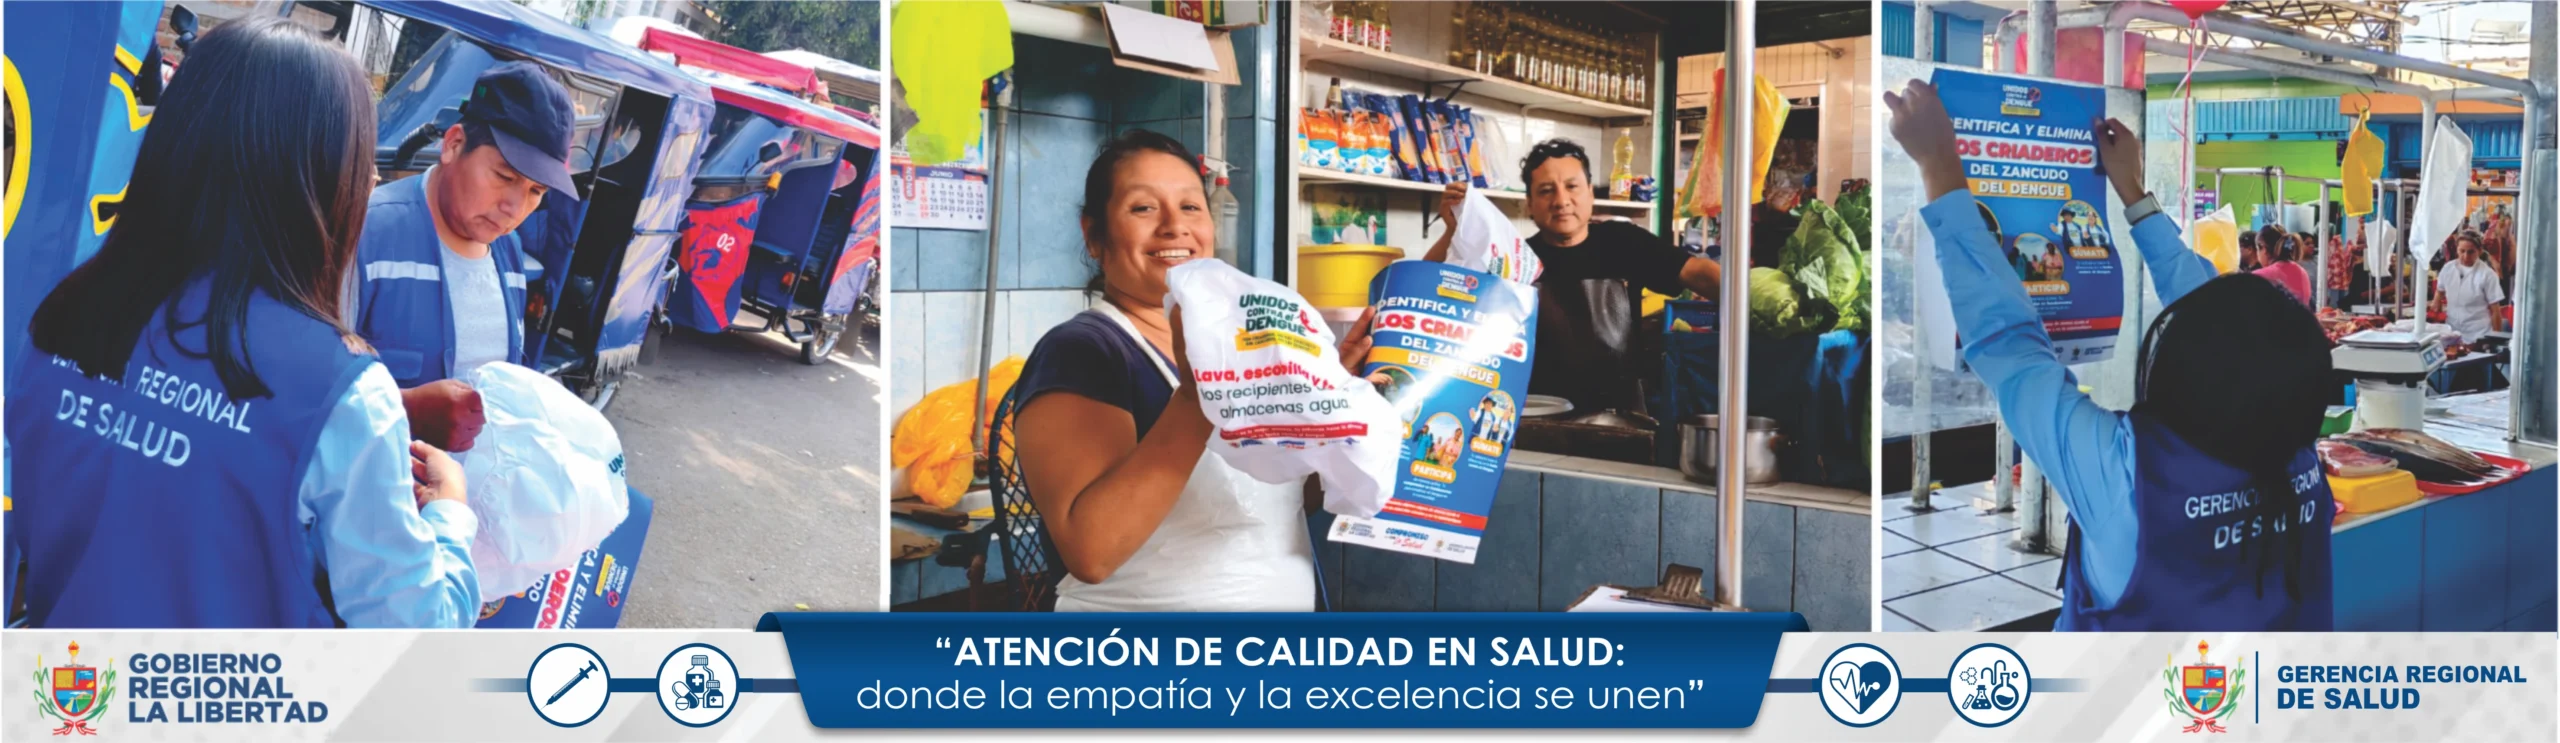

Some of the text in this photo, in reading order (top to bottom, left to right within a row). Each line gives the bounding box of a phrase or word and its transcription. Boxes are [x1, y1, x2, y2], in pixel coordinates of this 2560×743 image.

[1953, 118, 2093, 141] ENTIFICA Y ELIMINA
[1956, 139, 2093, 165] OS CRIADEROS
[1970, 163, 2069, 181] DEL ZANCUDO
[1979, 181, 2066, 197] DEL DENGUE
[716, 232, 735, 252] 02
[2026, 283, 2067, 293] ARTICIPA
[1239, 294, 1299, 312] UNIDOS
[1377, 296, 1471, 319] DENTIFICA Y
[1246, 315, 1306, 336] DENGUE
[1375, 313, 1415, 330] LOS
[1401, 335, 1426, 351] DEL
[1194, 368, 1240, 383] Lava,
[135, 365, 251, 434] REGIONAL
[1200, 388, 1223, 401] los
[1226, 382, 1312, 399] recipientes
[1220, 401, 1304, 419] almacenas
[55, 389, 191, 467] DE SALUD
[2185, 488, 2261, 519] GERENC
[2213, 520, 2245, 550] DE
[563, 584, 588, 629] ELIMI
